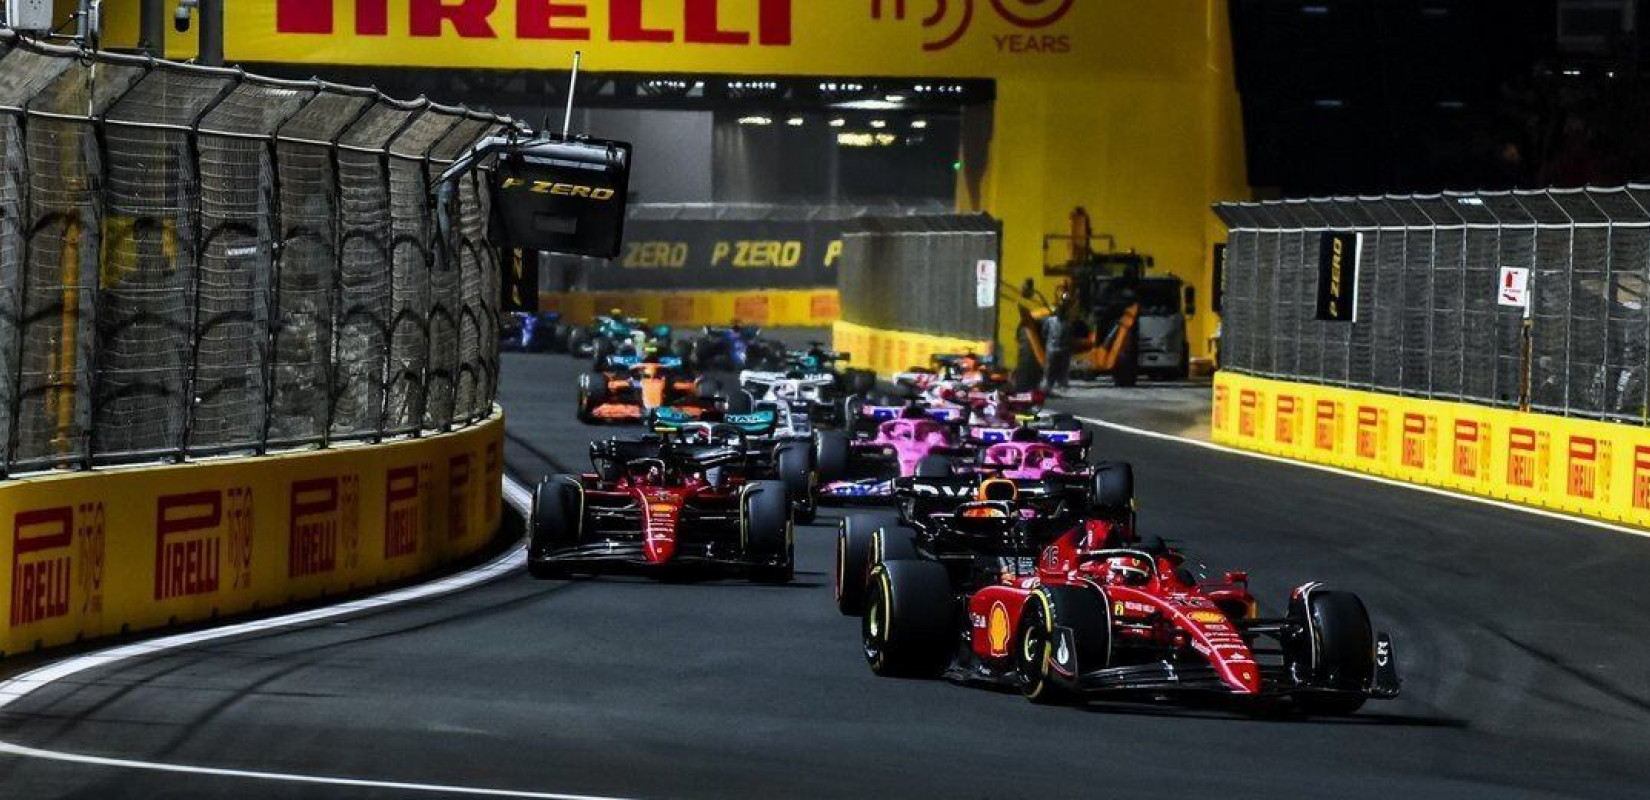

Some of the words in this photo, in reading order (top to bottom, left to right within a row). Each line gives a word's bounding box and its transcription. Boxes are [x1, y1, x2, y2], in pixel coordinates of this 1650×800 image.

[993, 34, 1071, 53] YEARS
[530, 180, 615, 201] ZERO
[623, 241, 689, 268] ZERO
[711, 241, 730, 267] P
[732, 240, 801, 267] ZERO
[1331, 237, 1342, 298] ZERO
[1453, 418, 1478, 478] PIRELLI
[1507, 427, 1536, 488] PIRELLI
[1567, 434, 1597, 500] PIRELLI
[154, 489, 223, 601] PIRELLI
[288, 475, 340, 579] PIRELLI
[10, 505, 73, 628] PIRELLI
